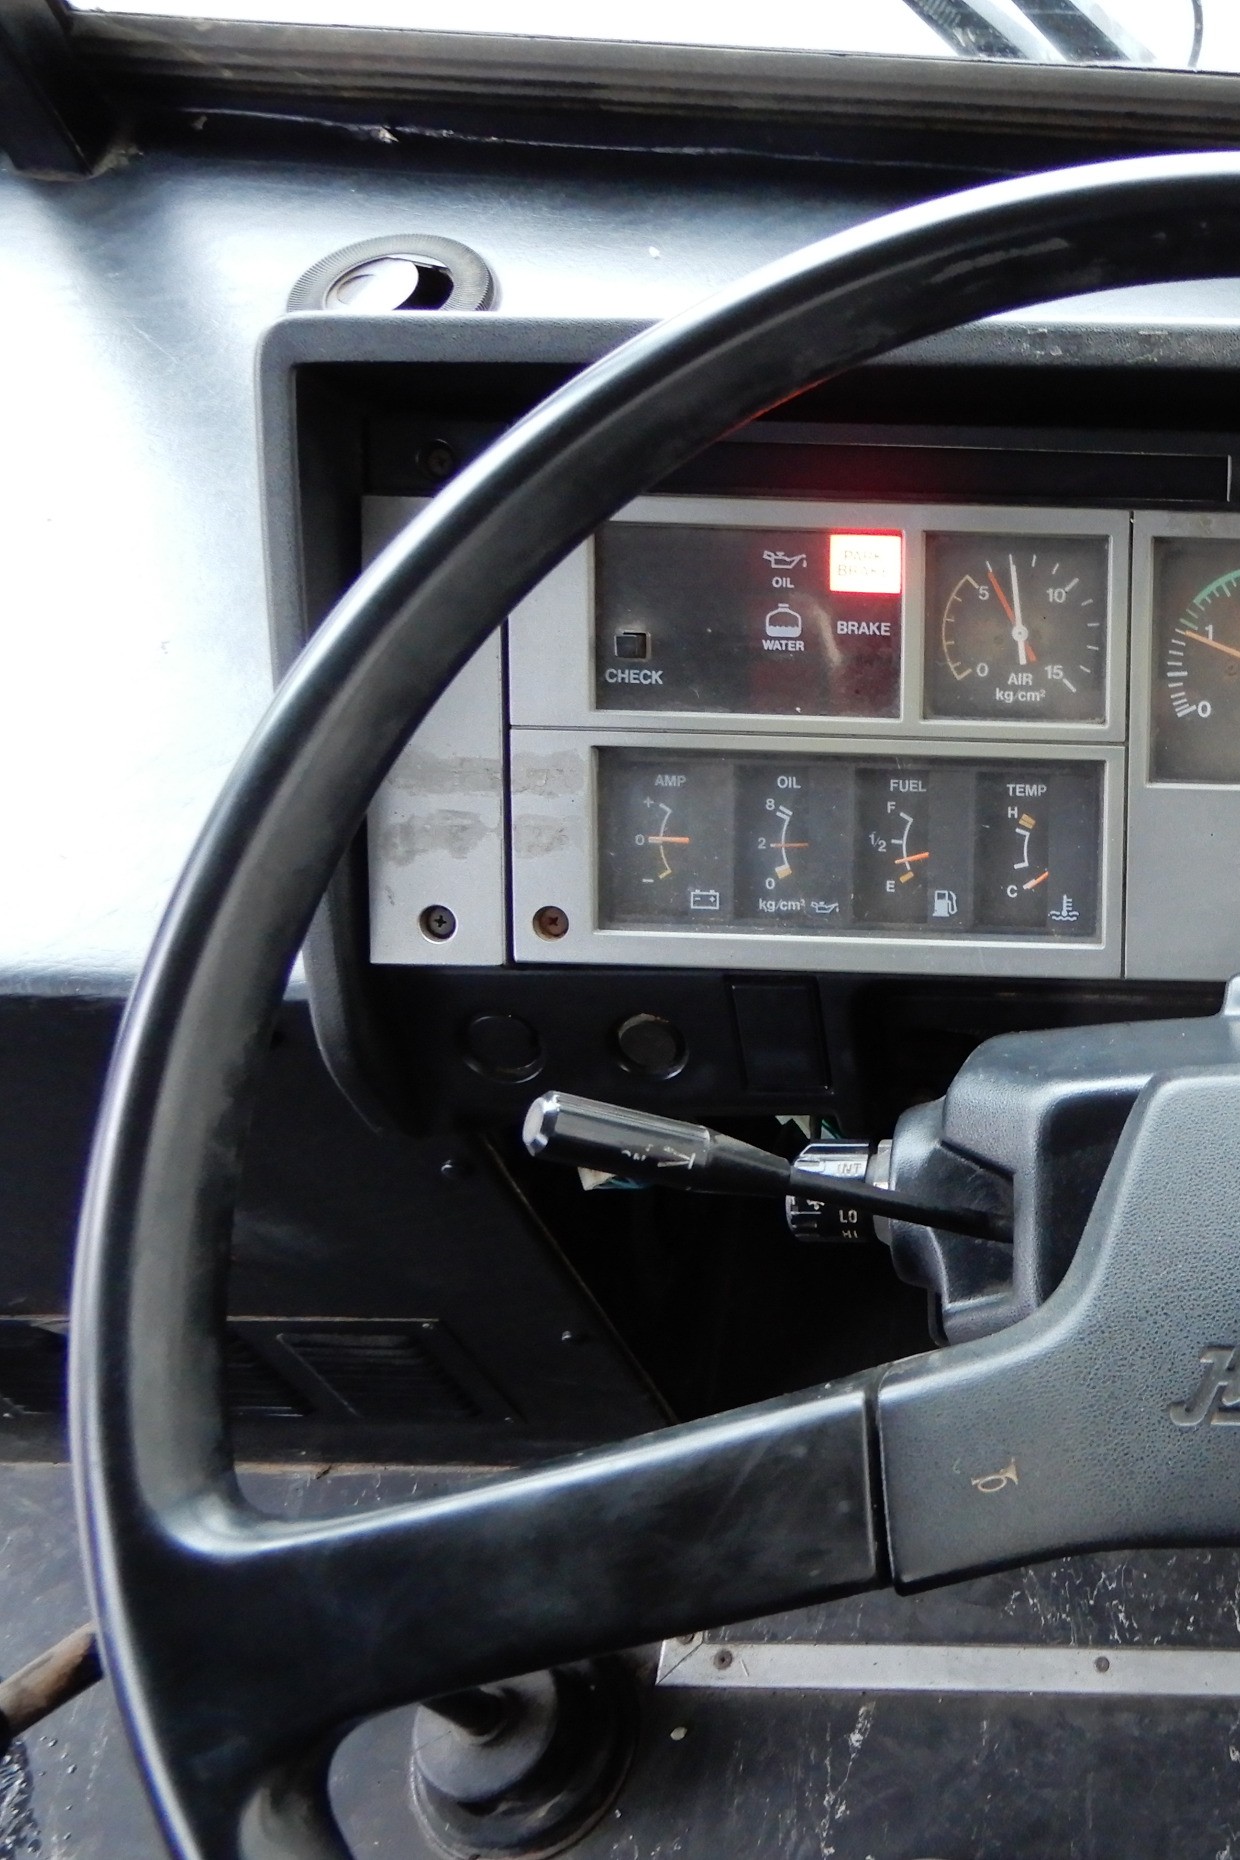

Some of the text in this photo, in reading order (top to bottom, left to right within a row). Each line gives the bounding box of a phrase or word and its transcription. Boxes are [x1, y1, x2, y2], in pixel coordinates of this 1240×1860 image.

[772, 576, 795, 589] OIL
[978, 586, 990, 600] 5
[1046, 588, 1067, 603] 10
[836, 621, 891, 637] BRAKE
[1205, 624, 1214, 640] 1
[762, 639, 805, 652] WATER
[976, 662, 989, 677] 0
[1044, 665, 1064, 680] 15
[605, 668, 664, 685] CHECK
[1007, 673, 1033, 686] AIR
[1197, 701, 1212, 718] 0
[655, 775, 687, 787] AMP
[777, 776, 802, 789] OIL
[889, 779, 927, 793] FUEL
[1006, 784, 1048, 797] TEMP
[765, 799, 776, 811] 8
[887, 801, 896, 813] F
[1007, 806, 1019, 819] H
[635, 834, 645, 846] 0
[758, 838, 767, 849] 2
[765, 878, 775, 890] 0
[886, 880, 896, 893] E
[1006, 885, 1018, 898] C
[839, 1209, 858, 1224] LO
